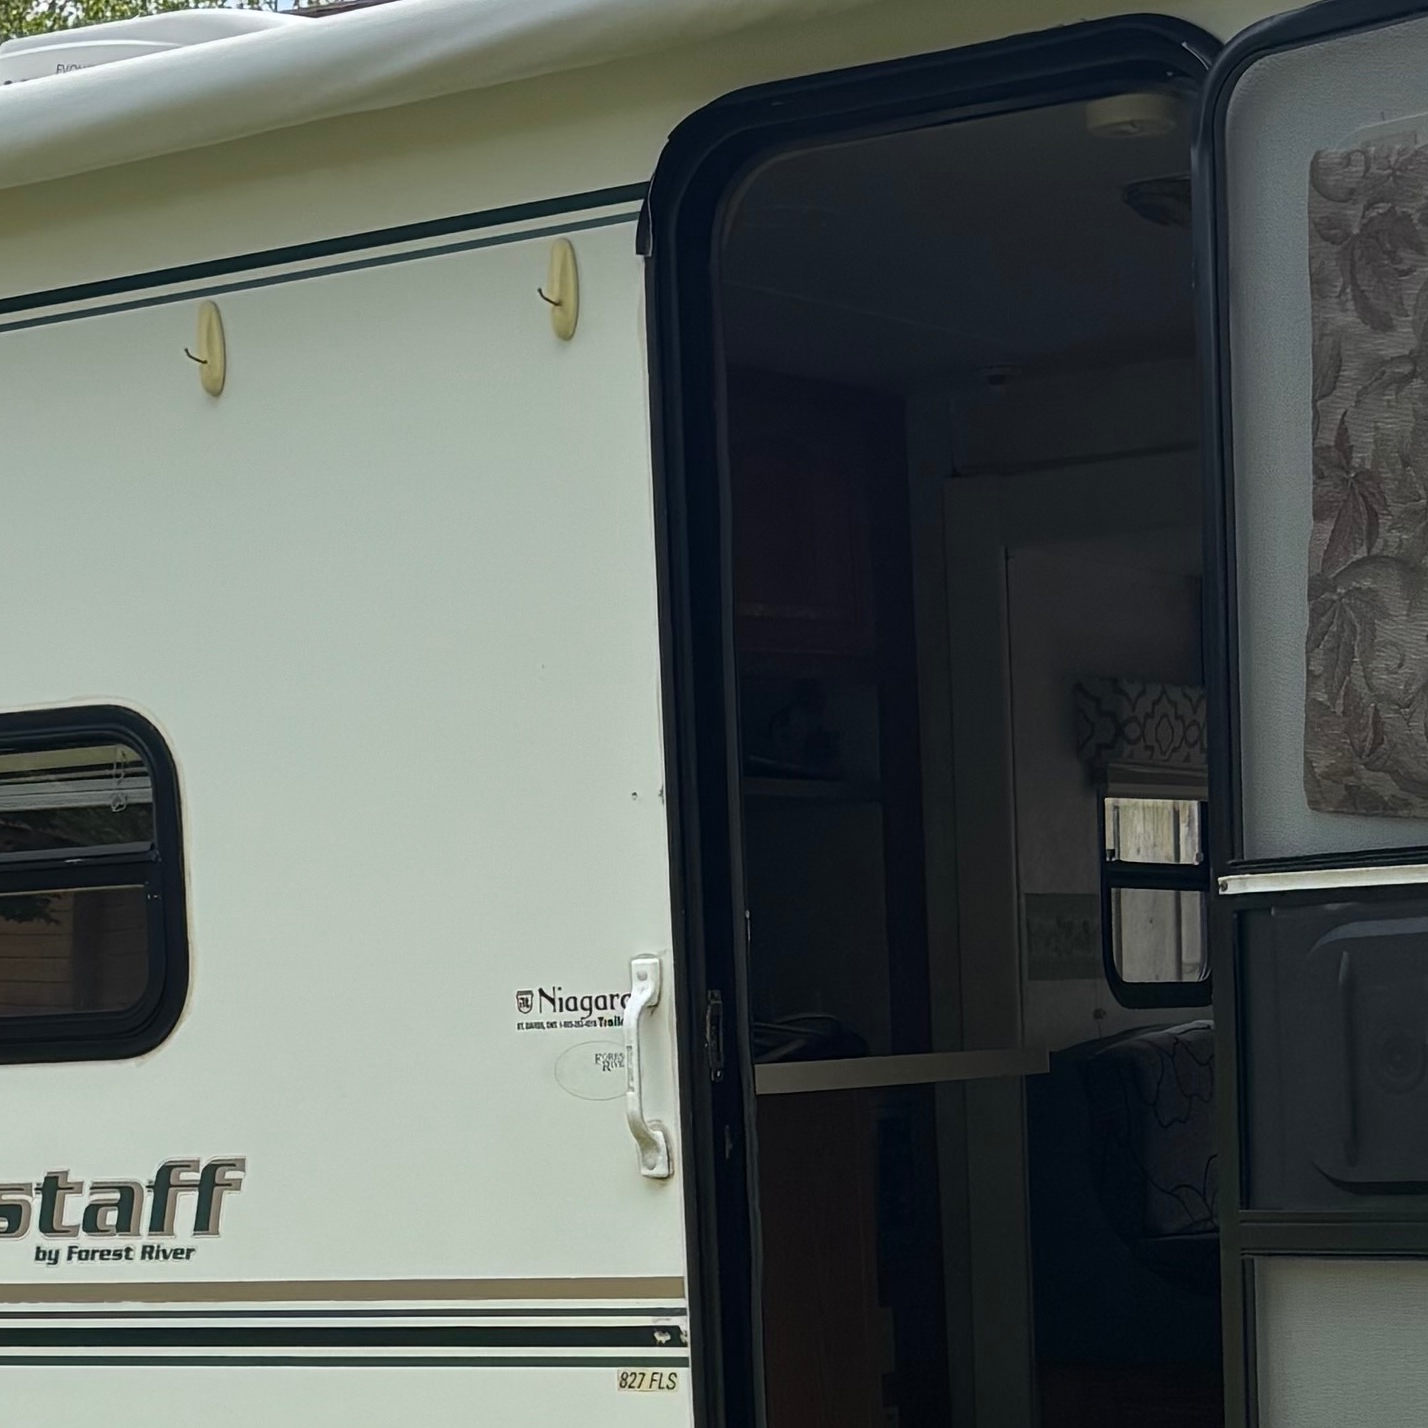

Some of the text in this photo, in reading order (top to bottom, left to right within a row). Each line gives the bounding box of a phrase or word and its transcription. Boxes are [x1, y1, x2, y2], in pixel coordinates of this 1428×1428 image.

[34, 1244, 196, 1265] by Forest River
[619, 1371, 678, 1390] 827 FLS
